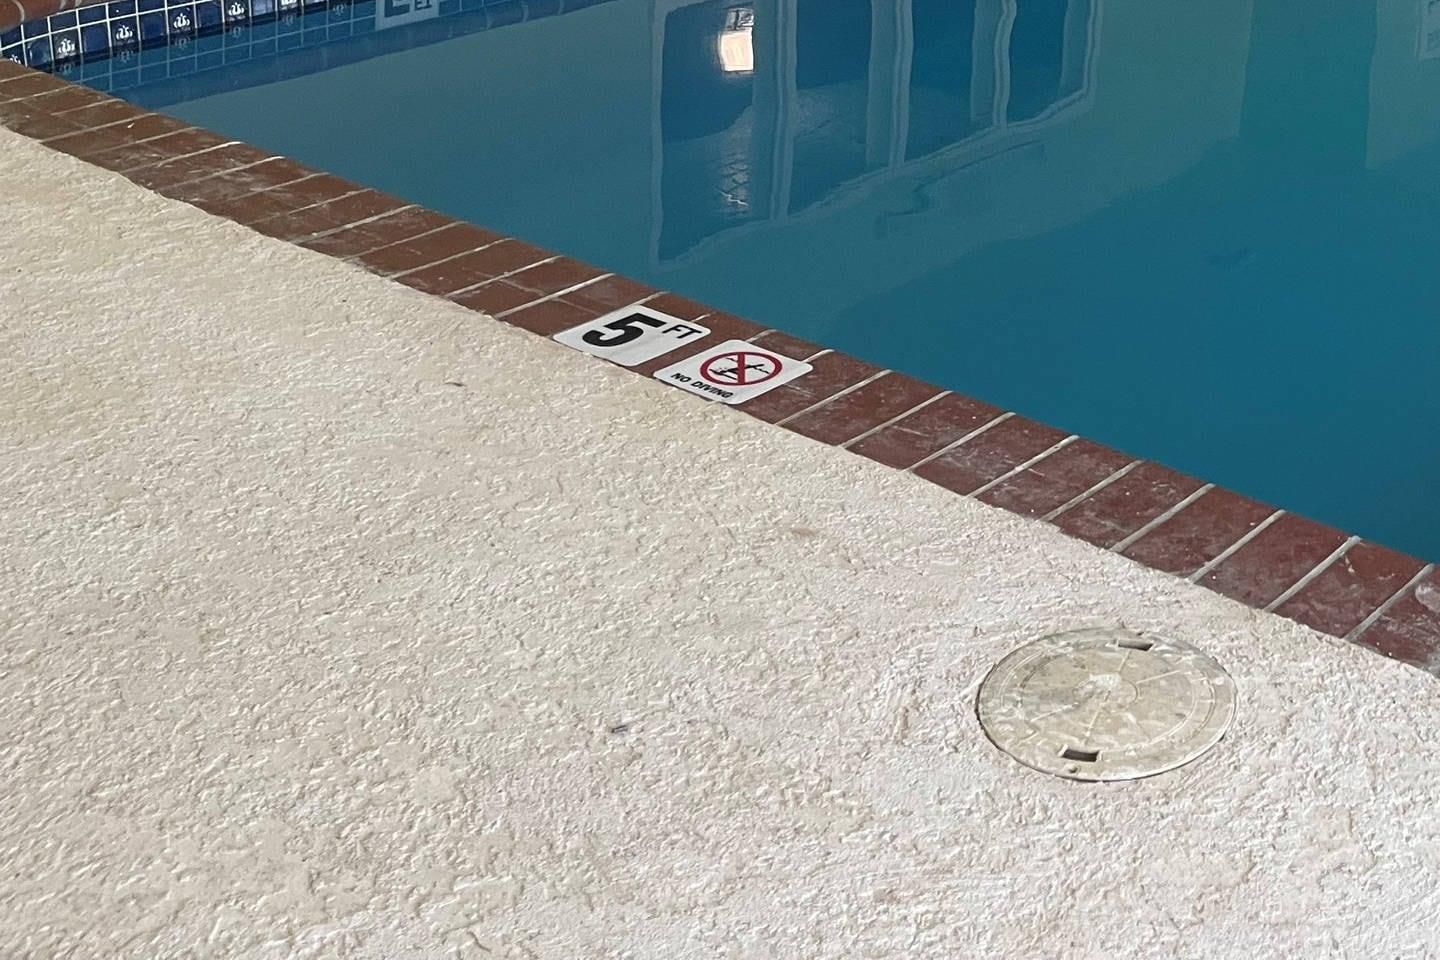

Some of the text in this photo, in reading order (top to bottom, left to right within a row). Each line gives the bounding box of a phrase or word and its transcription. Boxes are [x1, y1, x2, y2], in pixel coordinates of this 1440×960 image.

[582, 312, 703, 347] 5 FT
[670, 372, 734, 398] NO DIVING
